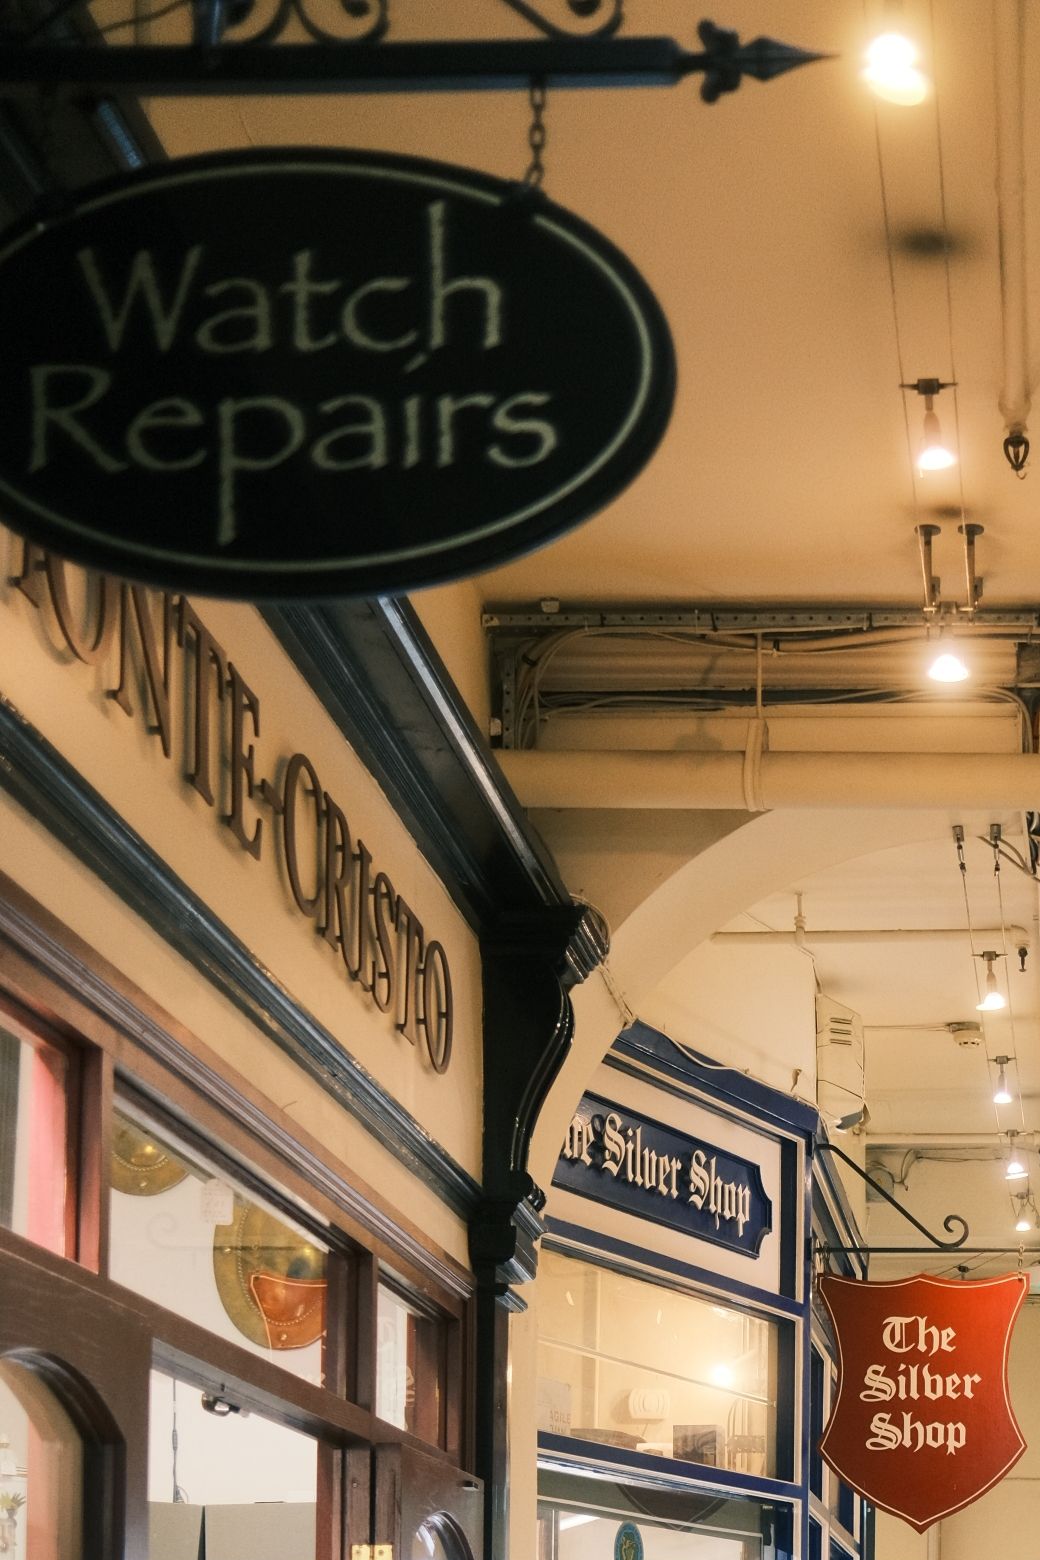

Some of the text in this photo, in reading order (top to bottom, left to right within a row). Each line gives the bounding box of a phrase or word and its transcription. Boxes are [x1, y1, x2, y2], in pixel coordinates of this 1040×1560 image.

[76, 200, 502, 354] Watch
[27, 354, 559, 547] Repairs
[602, 1113, 682, 1200] Silver
[688, 1149, 751, 1238] Shop
[882, 1315, 957, 1357] The
[859, 1363, 983, 1403] Silver
[865, 1411, 967, 1456] Shop
